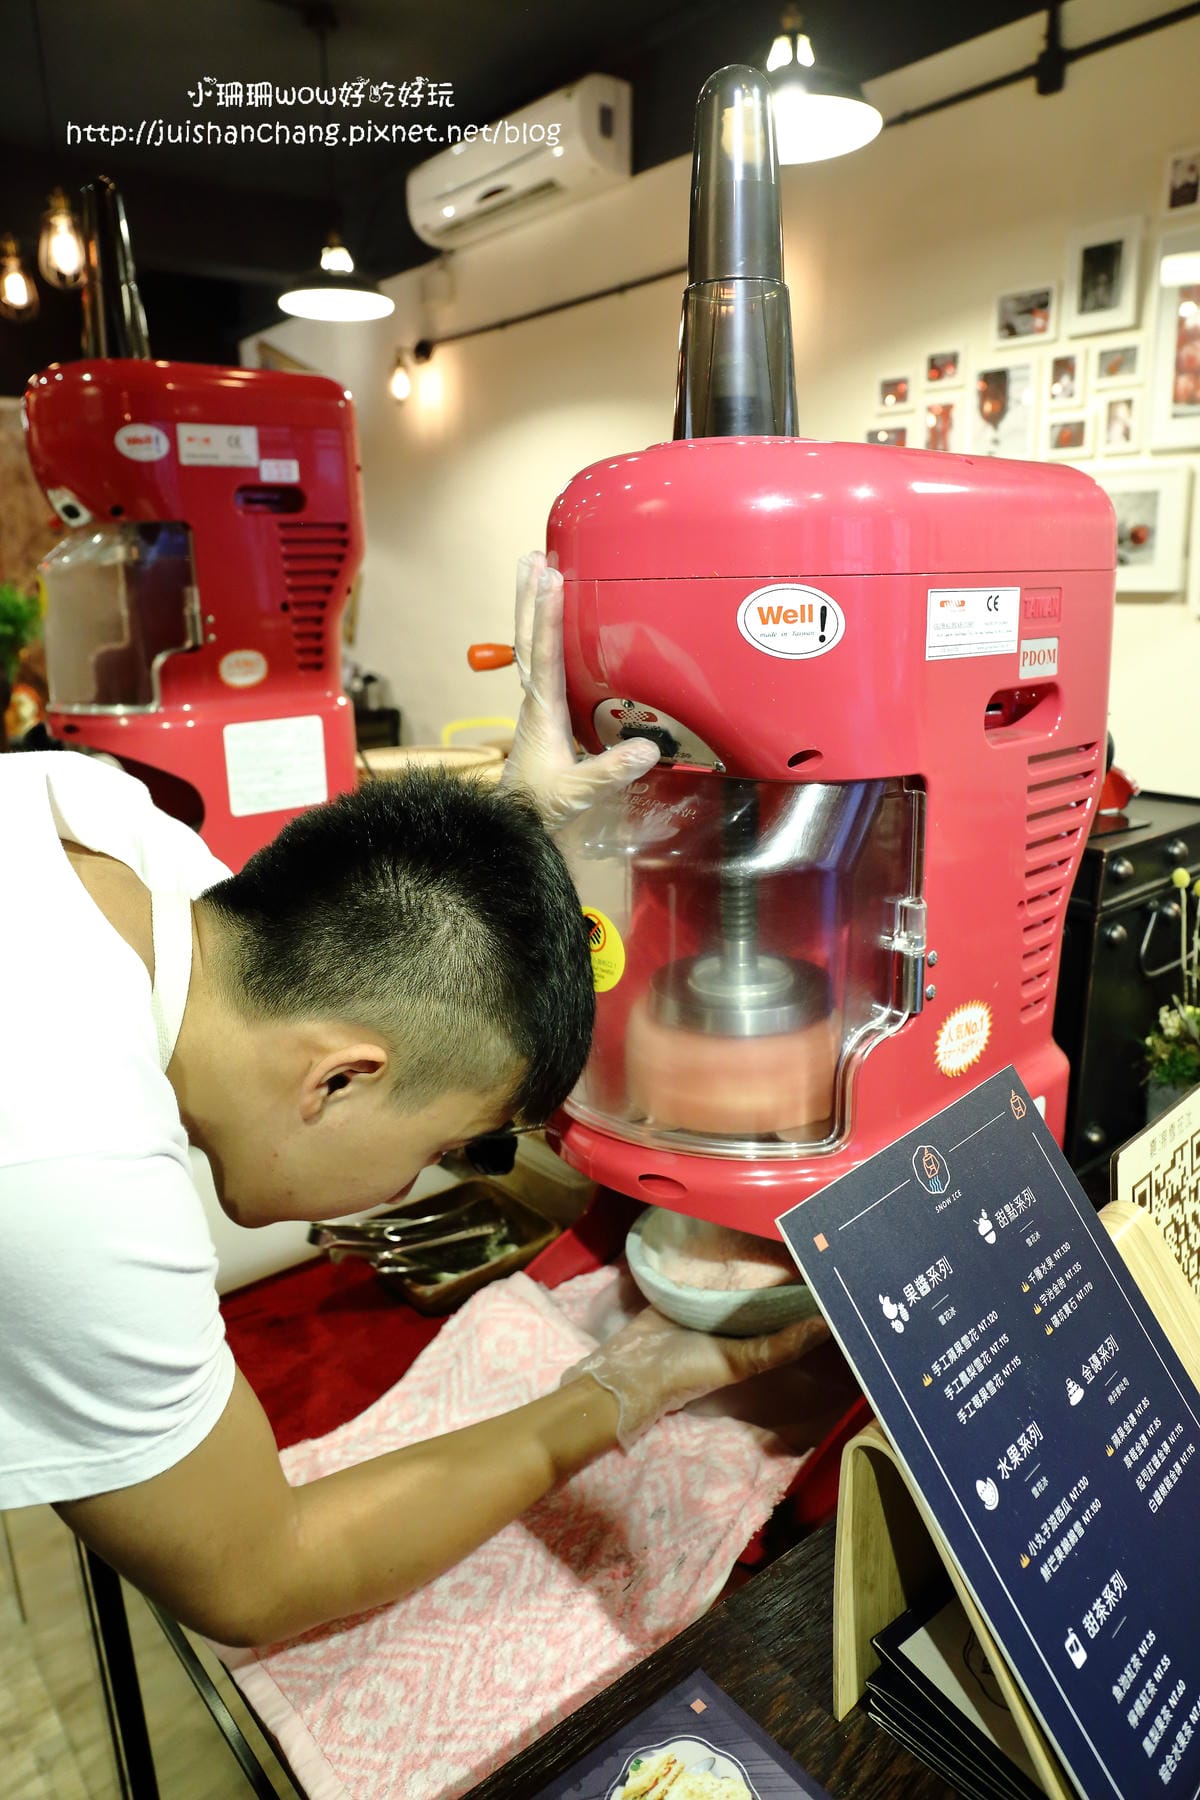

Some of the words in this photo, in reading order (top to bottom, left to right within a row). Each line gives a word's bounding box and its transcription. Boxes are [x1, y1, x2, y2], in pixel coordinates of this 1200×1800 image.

[986, 595, 1000, 612] CE
[1021, 648, 1057, 668] PDOM
[935, 1198, 952, 1214] SNOW
[952, 1189, 963, 1201] ICE
[994, 1186, 1037, 1229] 甜點系列
[902, 1255, 954, 1307] 果醬系列
[1027, 1255, 1056, 1286] 千層水果
[1039, 1276, 1067, 1307] 宇治金時
[1075, 1281, 1095, 1302] NT.170
[931, 1327, 980, 1377] 手工蘋果雪花
[977, 1310, 999, 1333] NT.120
[943, 1350, 992, 1401] 手工鳳梨雪花
[989, 1333, 1010, 1356] NT.115
[1001, 1355, 1022, 1378] NT.115
[1081, 1334, 1120, 1384] 金磚系列
[1168, 1423, 1184, 1445] NT.115
[997, 1420, 1044, 1480] 水果系列
[1179, 1443, 1196, 1466] NT.115
[1069, 1475, 1089, 1503] NT.130
[1081, 1498, 1102, 1525] NT.150
[1082, 1569, 1128, 1639] 甜茶系列
[1138, 1629, 1157, 1658] NT.35
[1153, 1654, 1172, 1683] NT.55
[1168, 1679, 1187, 1709] NT.60
